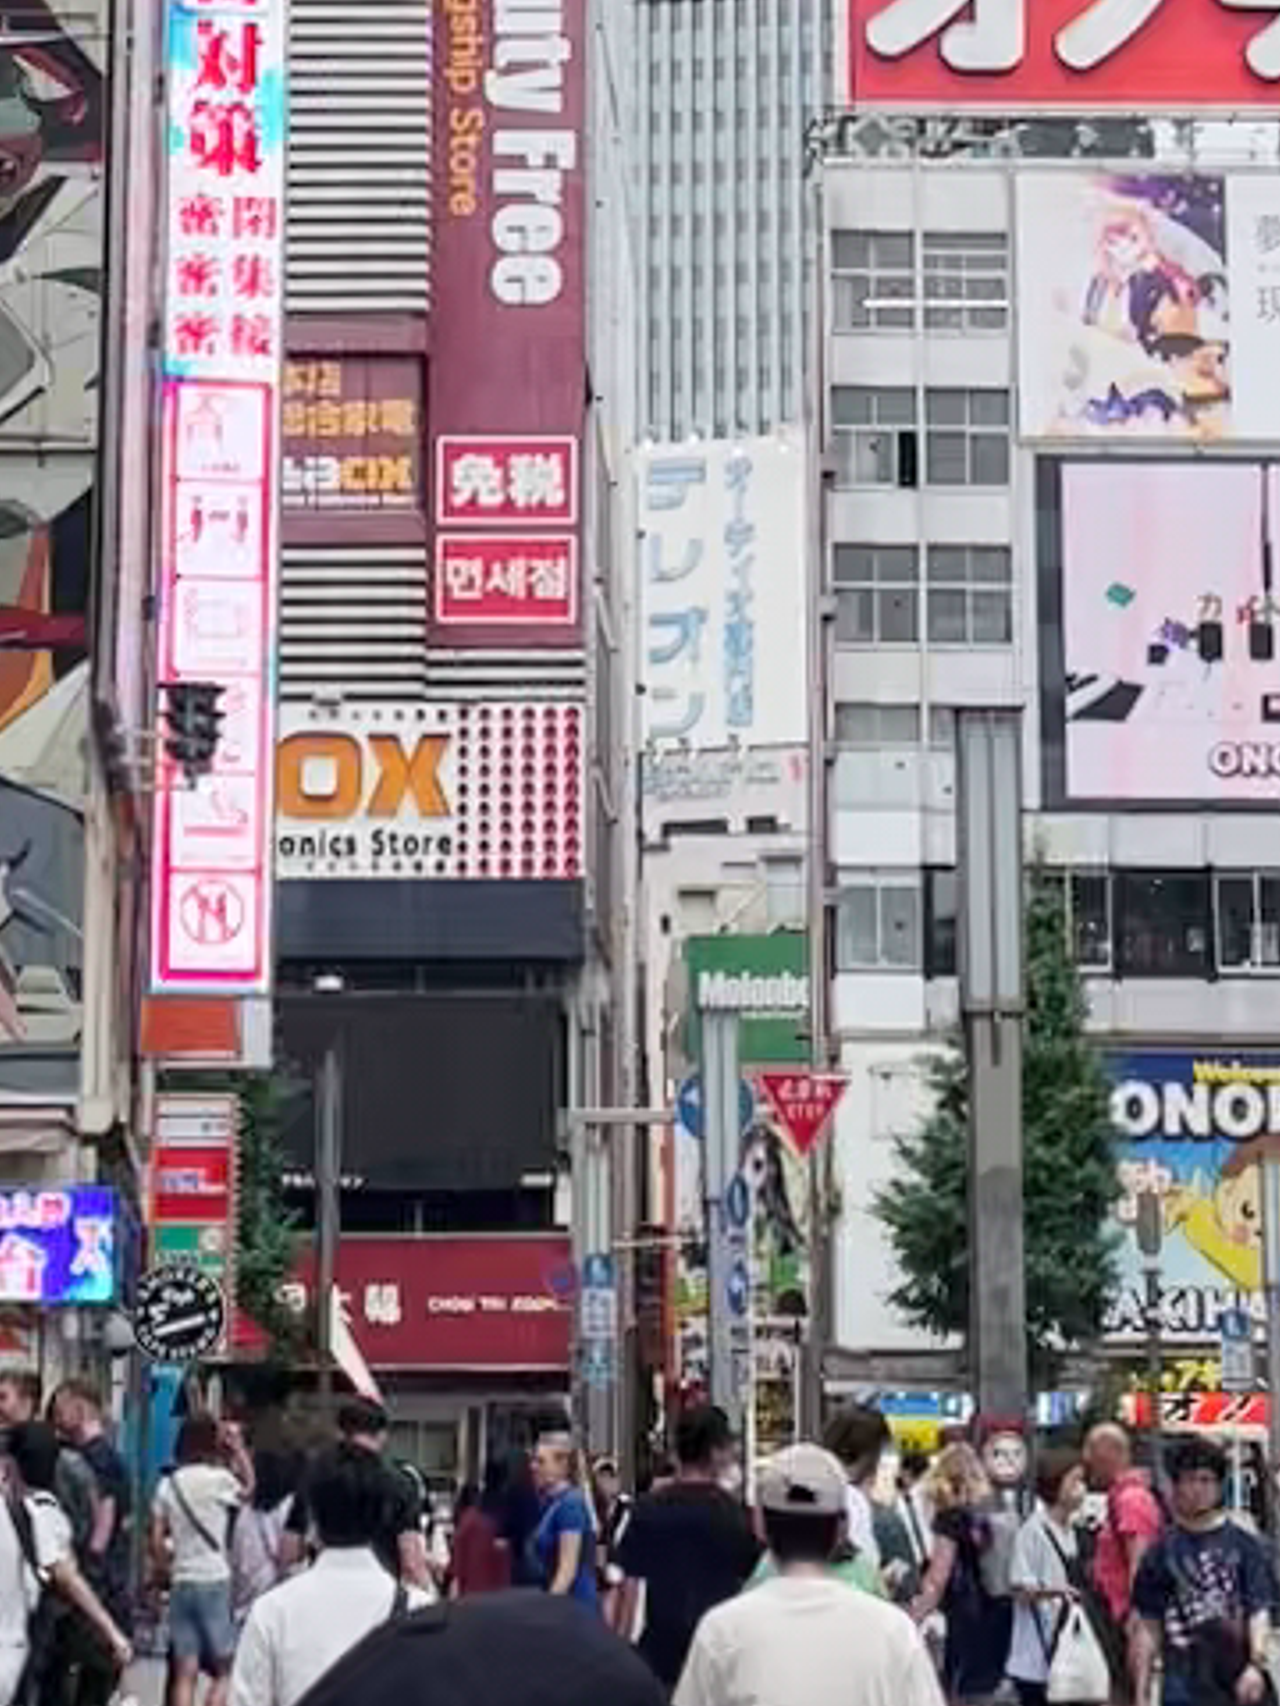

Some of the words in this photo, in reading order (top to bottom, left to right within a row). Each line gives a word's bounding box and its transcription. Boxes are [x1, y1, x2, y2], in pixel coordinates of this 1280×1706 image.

[448, 108, 484, 216] Store
[490, 129, 576, 306] Free
[451, 452, 564, 509] 免税
[446, 556, 570, 602] 면세점
[276, 732, 452, 820] OX
[371, 826, 452, 861] Store
